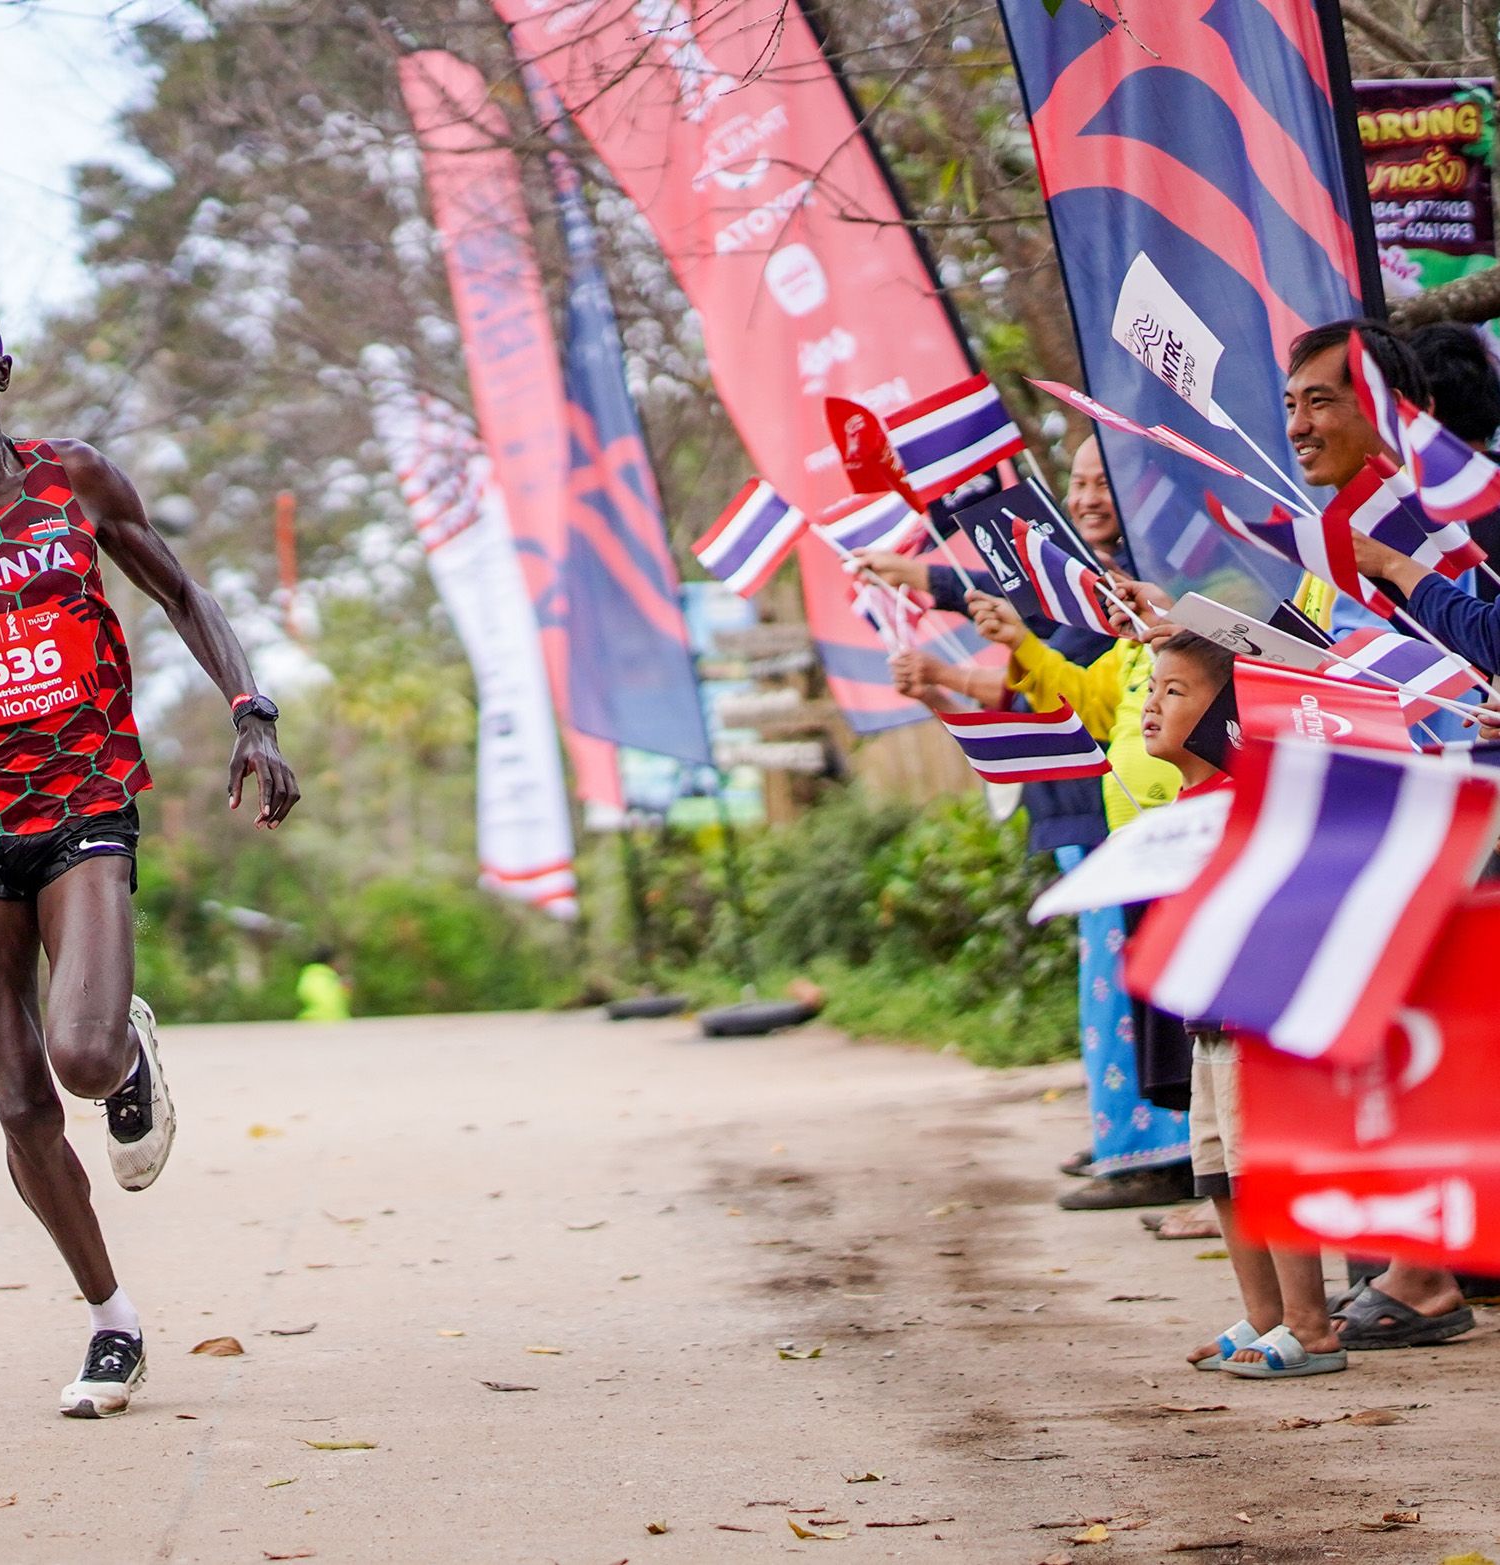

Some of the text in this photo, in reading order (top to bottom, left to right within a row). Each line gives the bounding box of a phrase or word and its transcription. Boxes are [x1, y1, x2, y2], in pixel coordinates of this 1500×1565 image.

[1371, 200, 1474, 218] 84-6173903
[28, 612, 60, 626] THAILAND
[22, 677, 62, 693] Kipngeno
[1300, 694, 1325, 744] HAILAND
